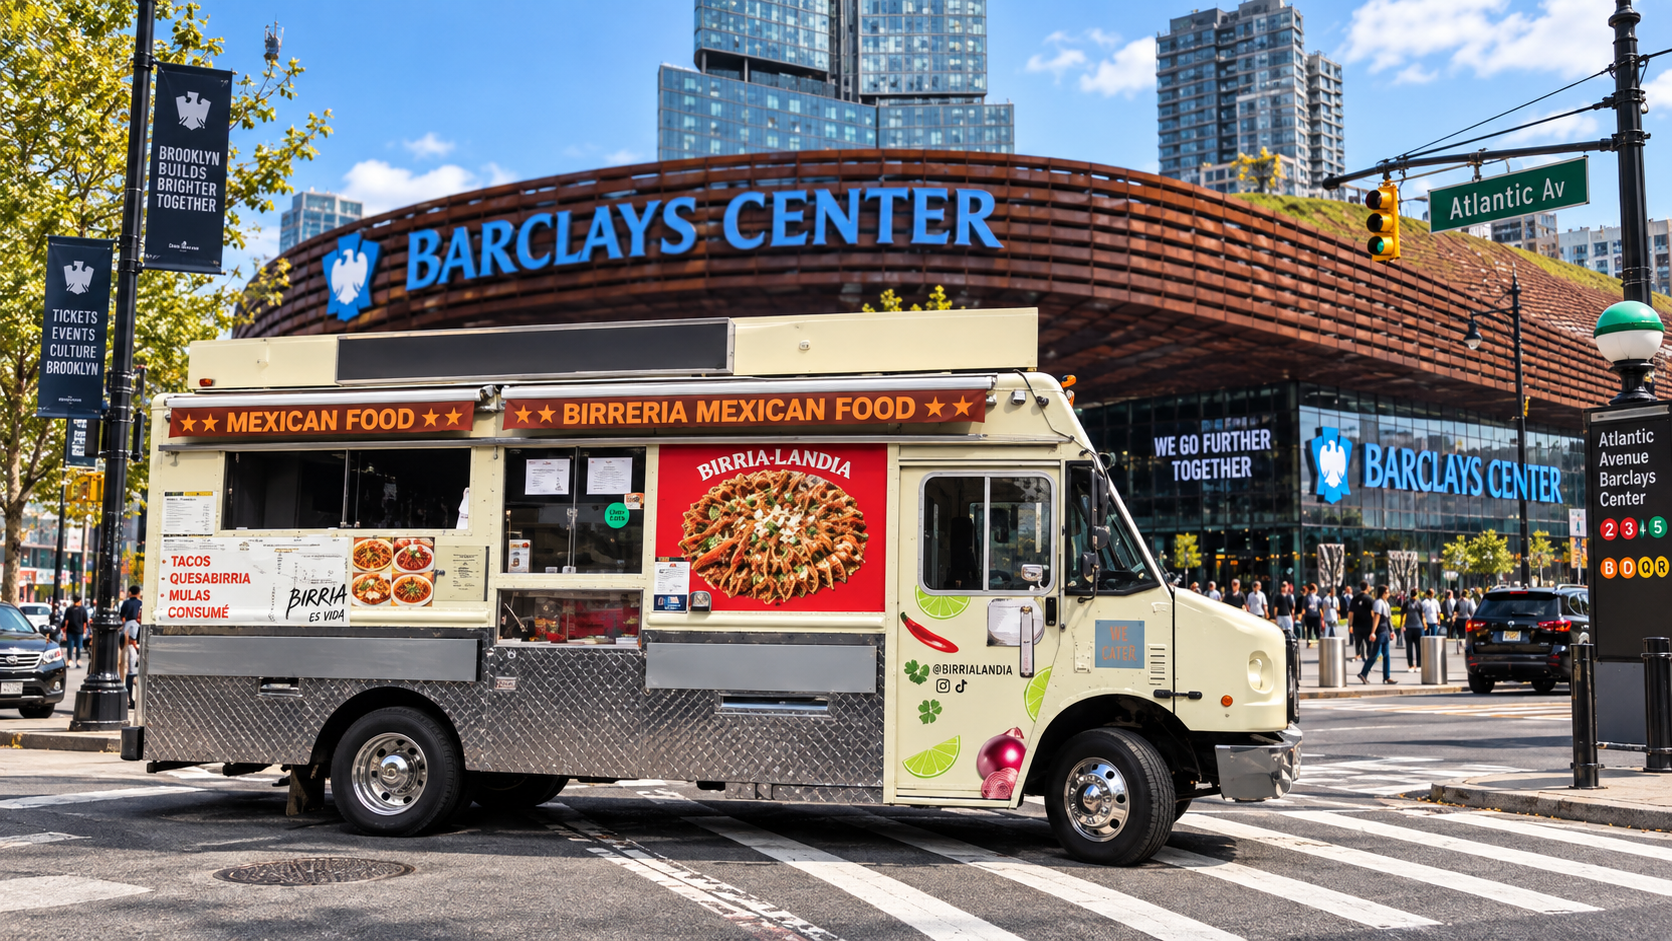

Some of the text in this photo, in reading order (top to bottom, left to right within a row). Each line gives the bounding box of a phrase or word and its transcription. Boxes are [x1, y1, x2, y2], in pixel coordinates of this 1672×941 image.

[159, 145, 220, 166] BROOKLYN
[158, 162, 207, 180] BUILDS
[157, 177, 217, 196] BRIGHTER
[156, 193, 217, 212] TOGETHER
[1450, 178, 1565, 220] Atlantic Av
[405, 187, 1004, 292] BARCLAYS CENTER
[52, 309, 98, 324] TICKETS
[51, 326, 96, 341] EVENTS
[49, 344, 97, 359] CULTURE
[46, 361, 99, 376] BROOKLYN
[563, 396, 916, 425] BIRRERIA MEXICAN FOOD
[226, 408, 415, 433] MEXICAN FOOD
[1154, 429, 1271, 457] WE GO FURTHER
[1599, 428, 1654, 447] Atlantic
[1599, 452, 1649, 467] Avenue
[1171, 456, 1252, 481] TOGETHER
[1364, 443, 1564, 504] BARCLAYS CENTER
[1600, 470, 1656, 488] Barclays
[1600, 491, 1646, 507] Center
[1605, 522, 1614, 537] 2
[1625, 521, 1633, 536] 3
[1654, 519, 1662, 534] 5
[171, 555, 211, 567] TACOS
[1605, 561, 1666, 575] B D Q R
[169, 572, 251, 585] QUESABIRRIA
[169, 589, 211, 601] MULAS
[285, 583, 348, 620] BIRRIA
[168, 604, 229, 619] CONSUMÉ
[309, 609, 345, 622] ES VIDA
[1109, 626, 1129, 642] WE
[1101, 645, 1138, 662] CATER
[932, 664, 1013, 676] @BIRRIALANDIA
